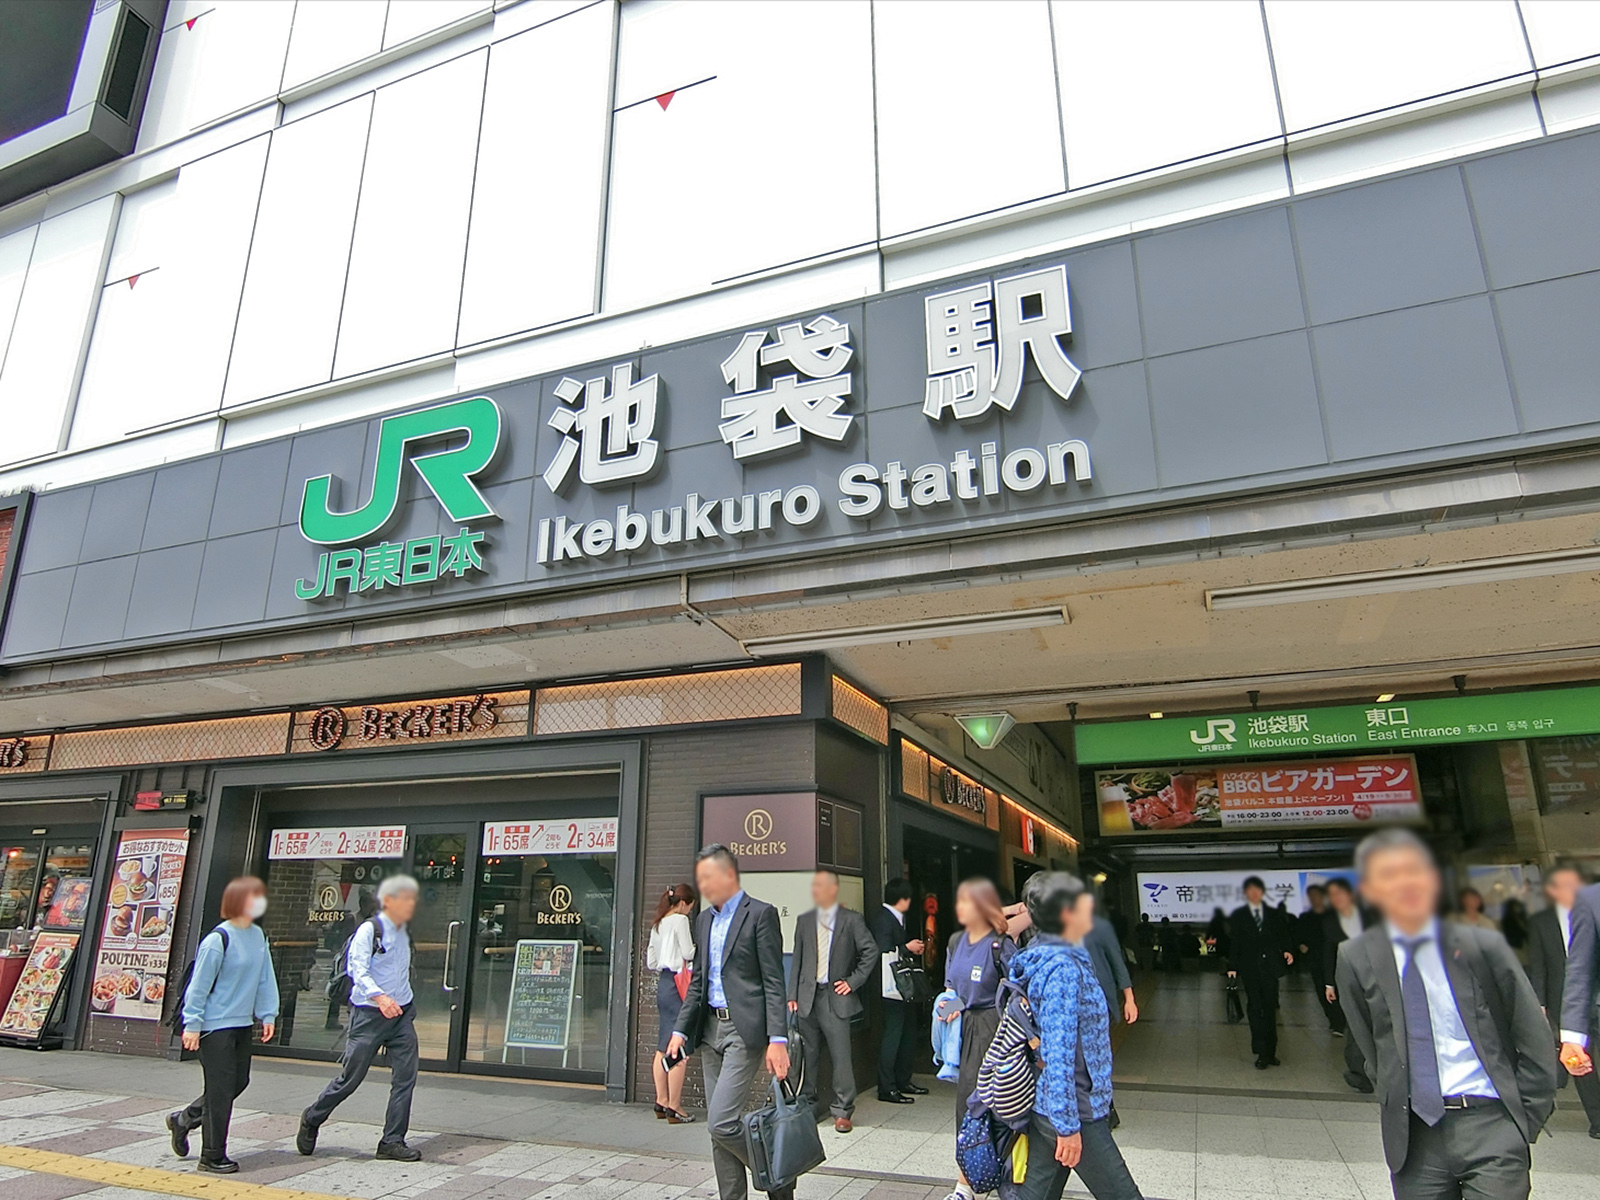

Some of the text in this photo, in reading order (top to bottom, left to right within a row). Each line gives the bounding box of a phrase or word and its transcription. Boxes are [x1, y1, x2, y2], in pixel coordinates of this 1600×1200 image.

[542, 263, 1083, 494] 池袋駅
[299, 396, 501, 545] JR
[536, 439, 1092, 566] Ikebukuro Station
[295, 527, 485, 600] JR東日本
[359, 694, 496, 741] BECKER'S
[1248, 714, 1310, 735] 池袋駅
[1365, 707, 1410, 728] 東口
[1532, 718, 1555, 730] 입구
[1190, 719, 1237, 744] JR
[1248, 732, 1357, 749] Ikebukuro Station
[1368, 726, 1462, 741] East Entrance
[1198, 743, 1233, 752] JR東日本
[1223, 772, 1260, 780] ハワイアン
[273, 833, 308, 855] 1F 65席
[337, 831, 351, 855] 2F
[353, 838, 376, 854] 34席
[487, 826, 530, 851] 1F 65席
[566, 823, 584, 849] 2F
[587, 831, 616, 848] 34席
[730, 841, 787, 856] BECKER'S
[537, 911, 582, 925] BECKER'S
[100, 952, 150, 967] POUTINE
